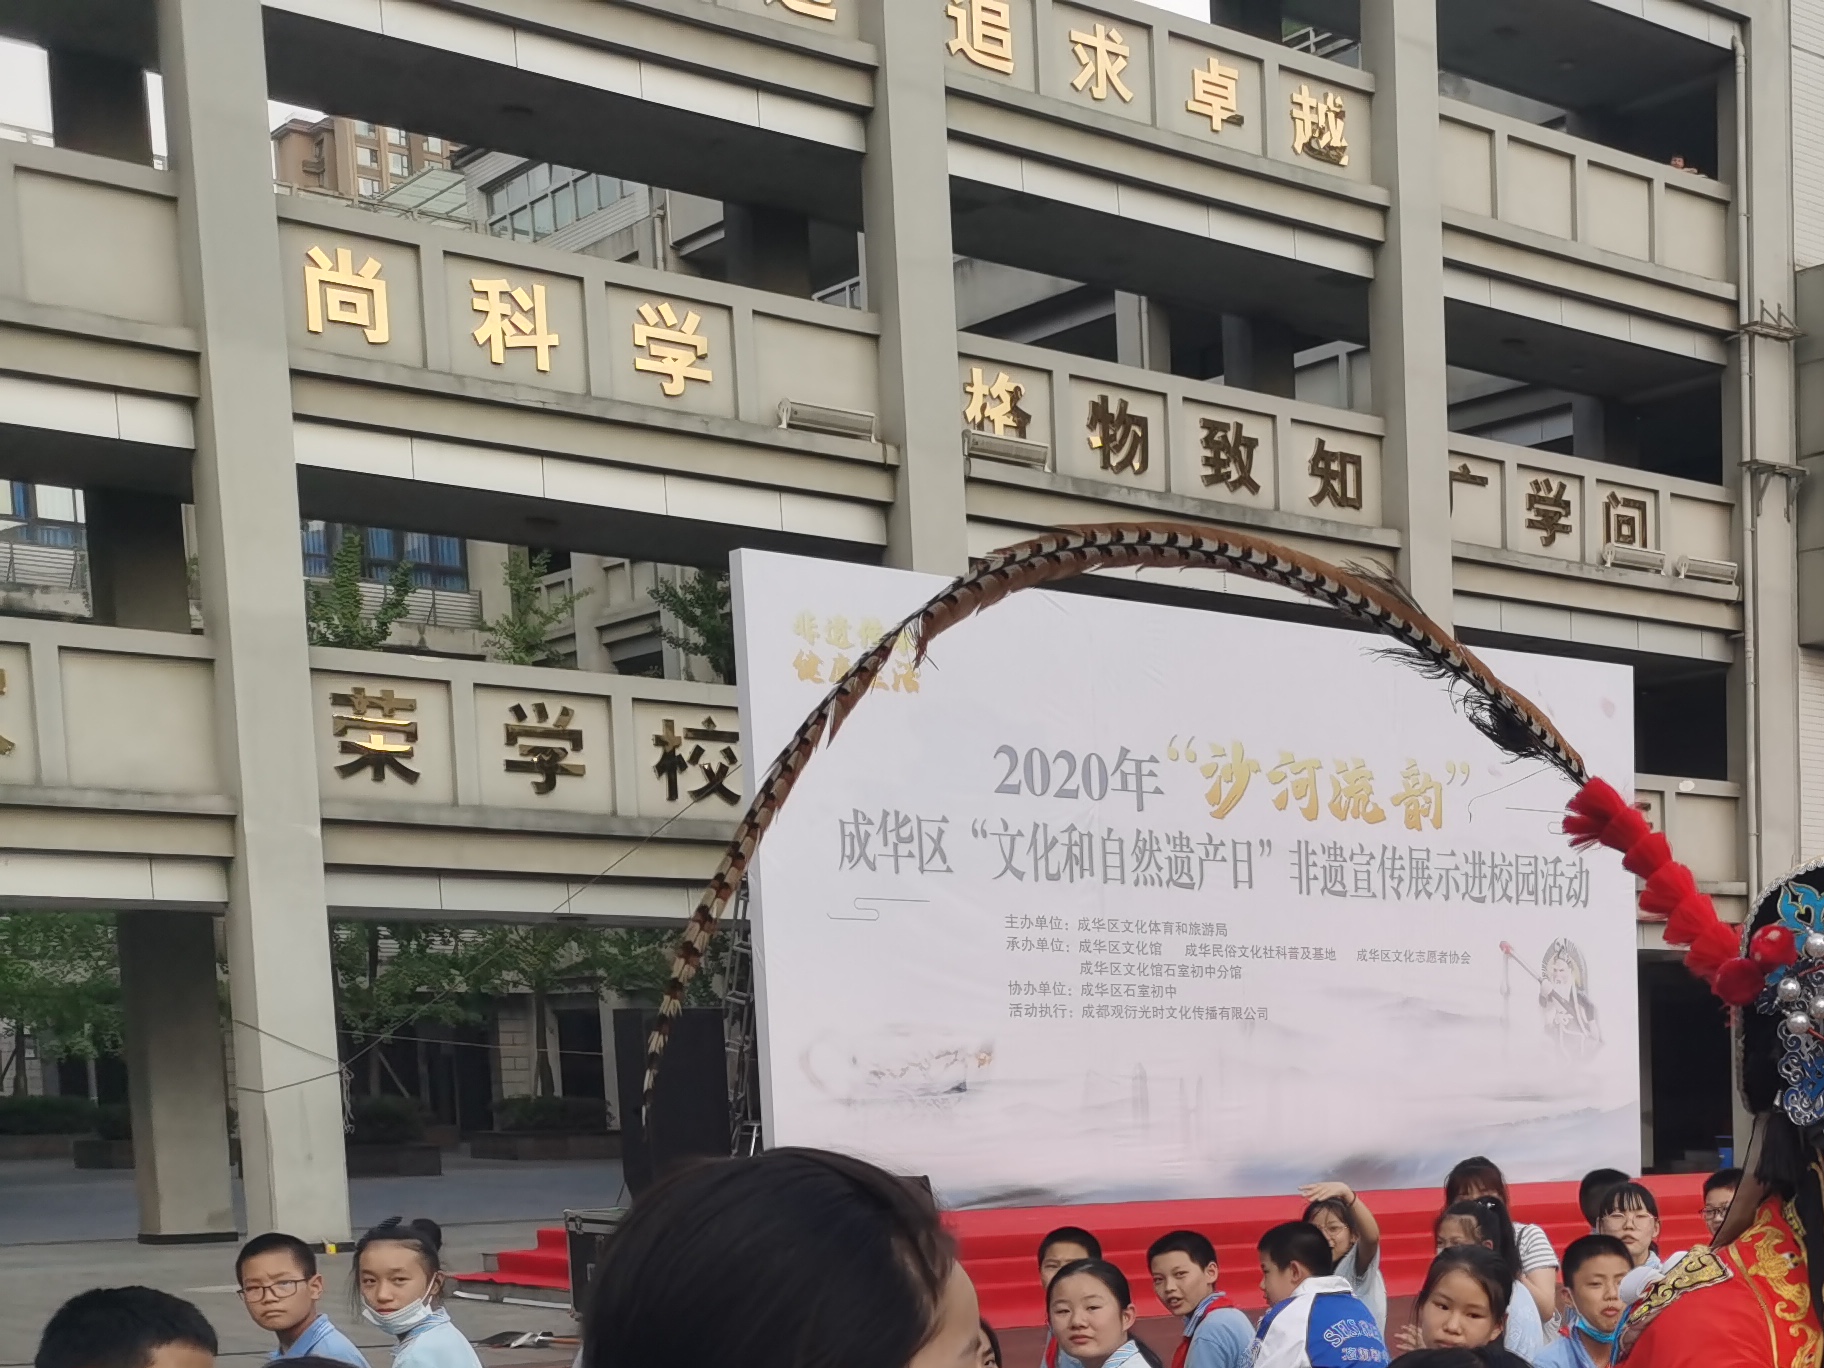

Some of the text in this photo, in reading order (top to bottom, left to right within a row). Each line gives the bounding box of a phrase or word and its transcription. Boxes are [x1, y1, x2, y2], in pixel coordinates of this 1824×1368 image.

[946, 0, 1350, 167] 追求卓越
[303, 246, 713, 397] 尚科学
[963, 367, 1363, 511] 格物致知
[792, 610, 914, 658] 非遗传
[330, 687, 742, 805] 荣学校
